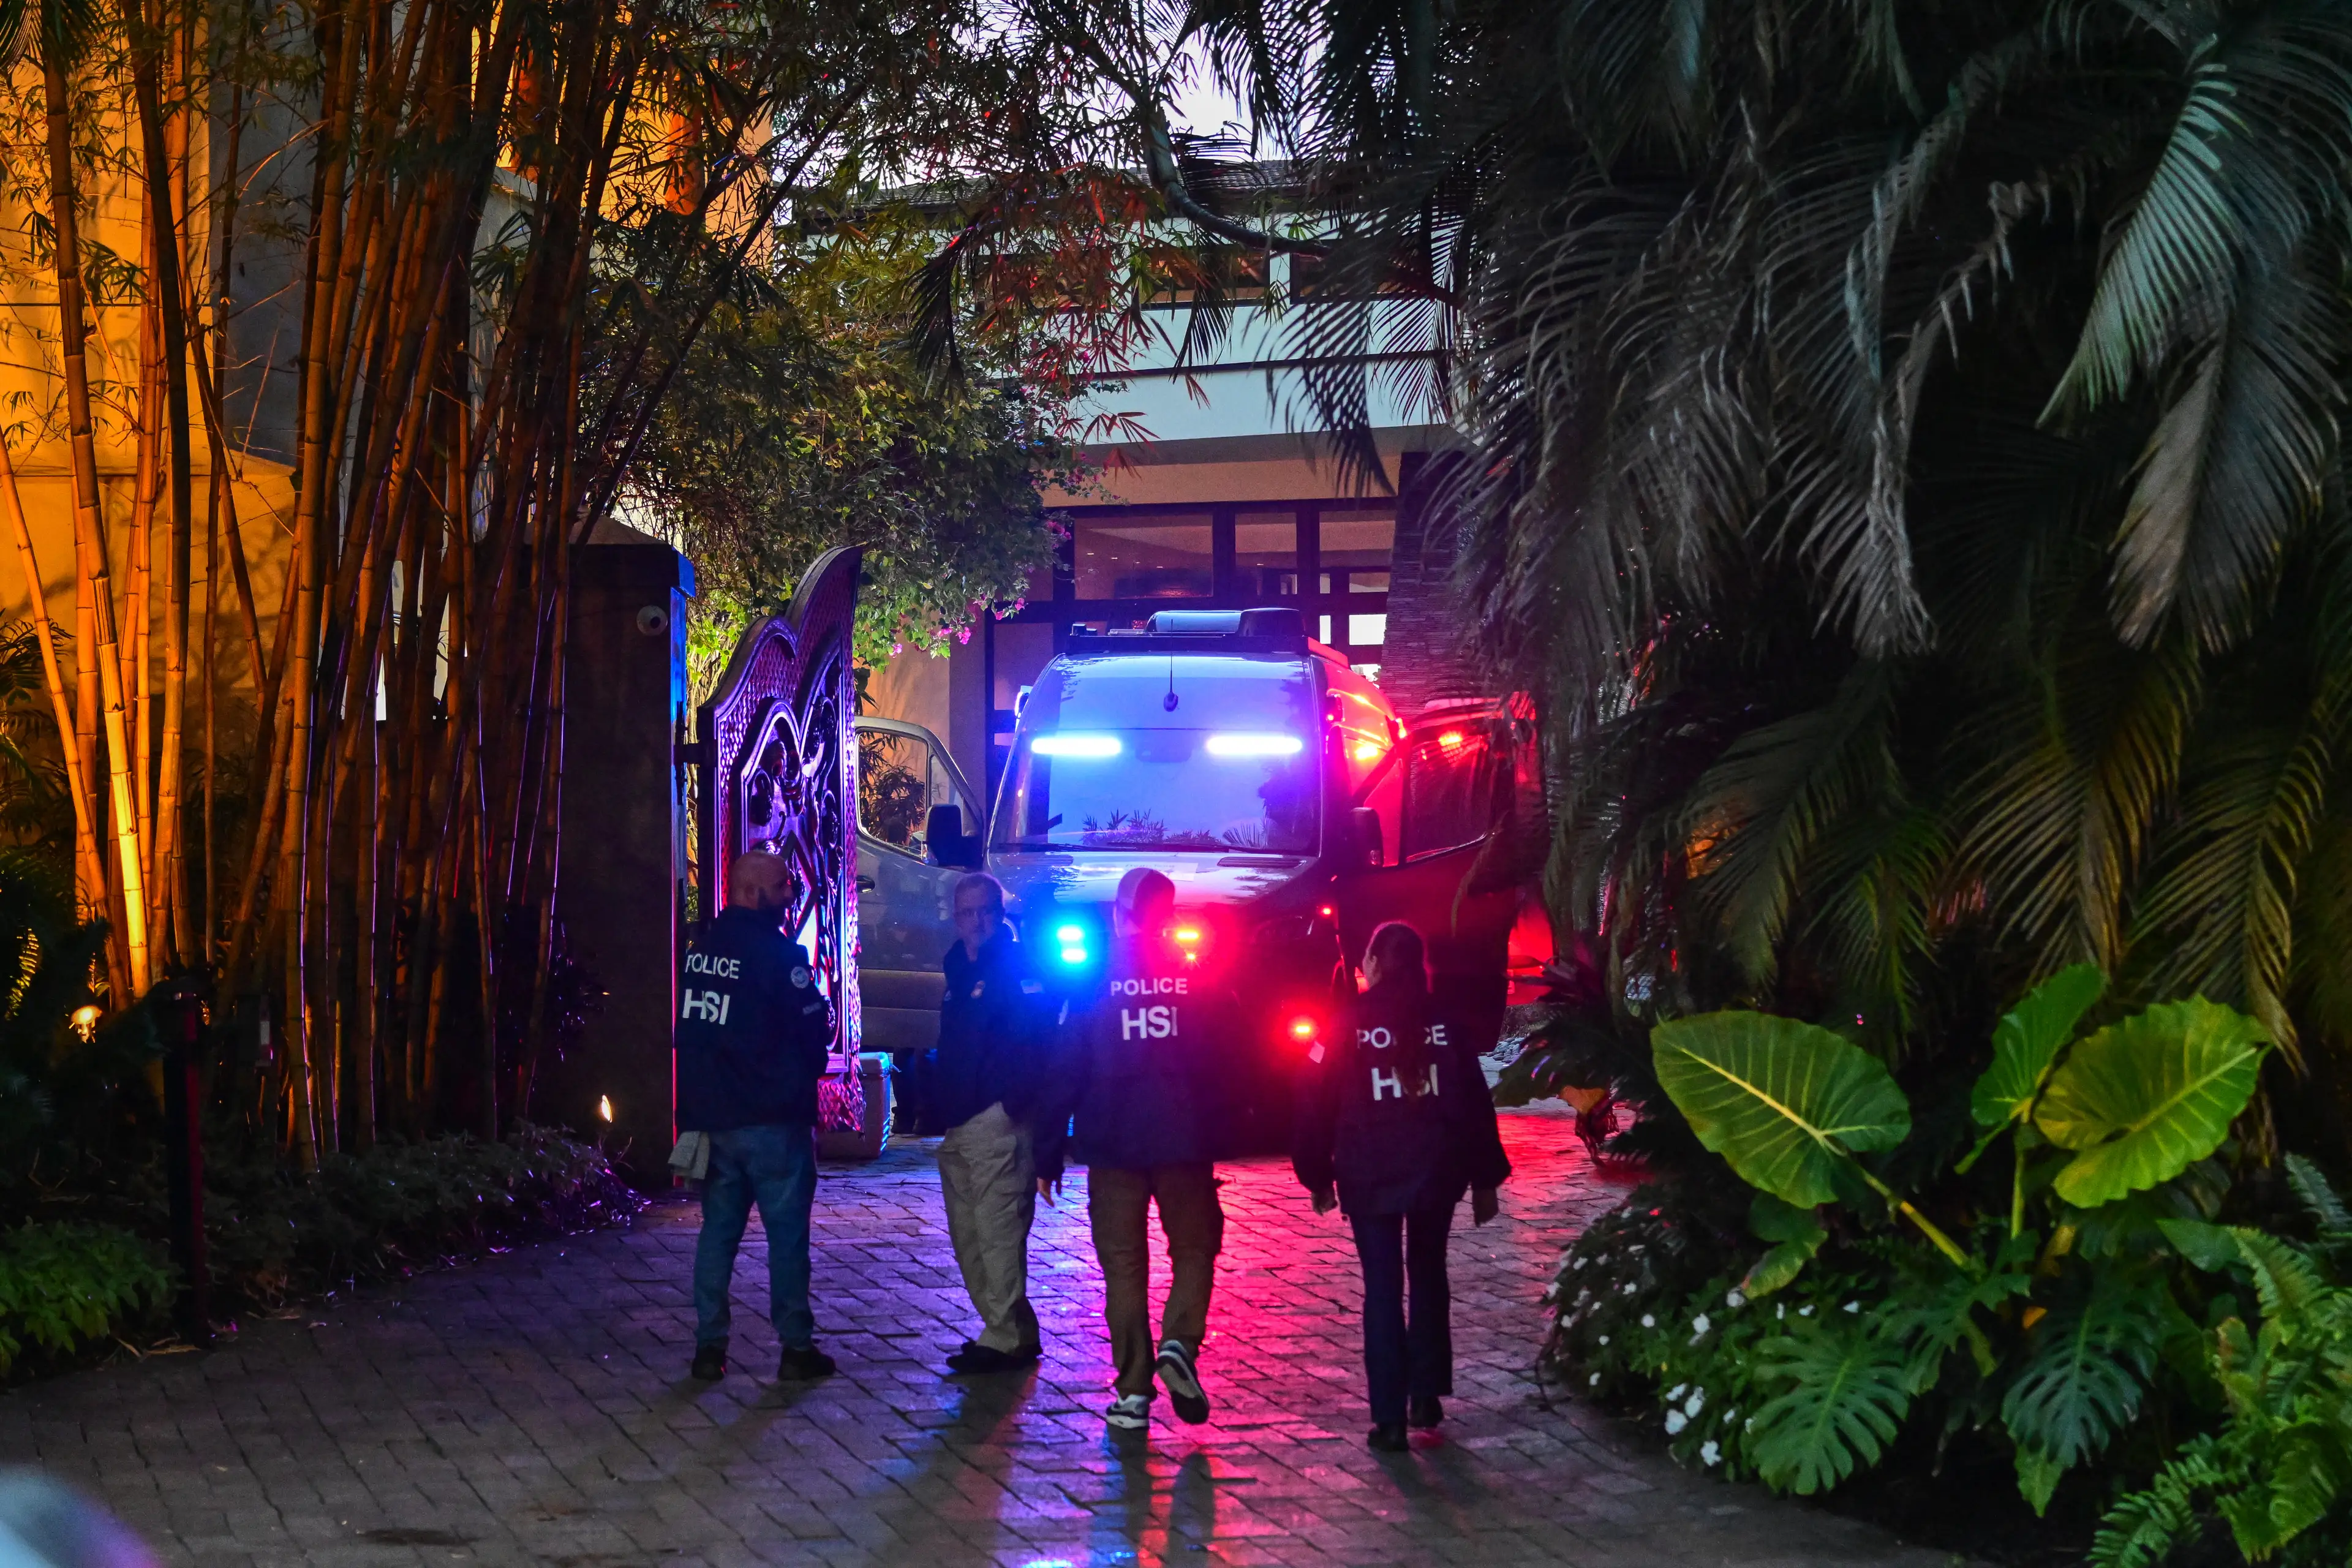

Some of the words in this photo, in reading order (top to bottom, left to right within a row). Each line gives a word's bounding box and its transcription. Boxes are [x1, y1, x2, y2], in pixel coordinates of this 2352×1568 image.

[1110, 978, 1188, 996] POLICE
[682, 989, 730, 1025] HSI
[1121, 1005, 1178, 1040] HSI
[1356, 1024, 1448, 1049] POE
